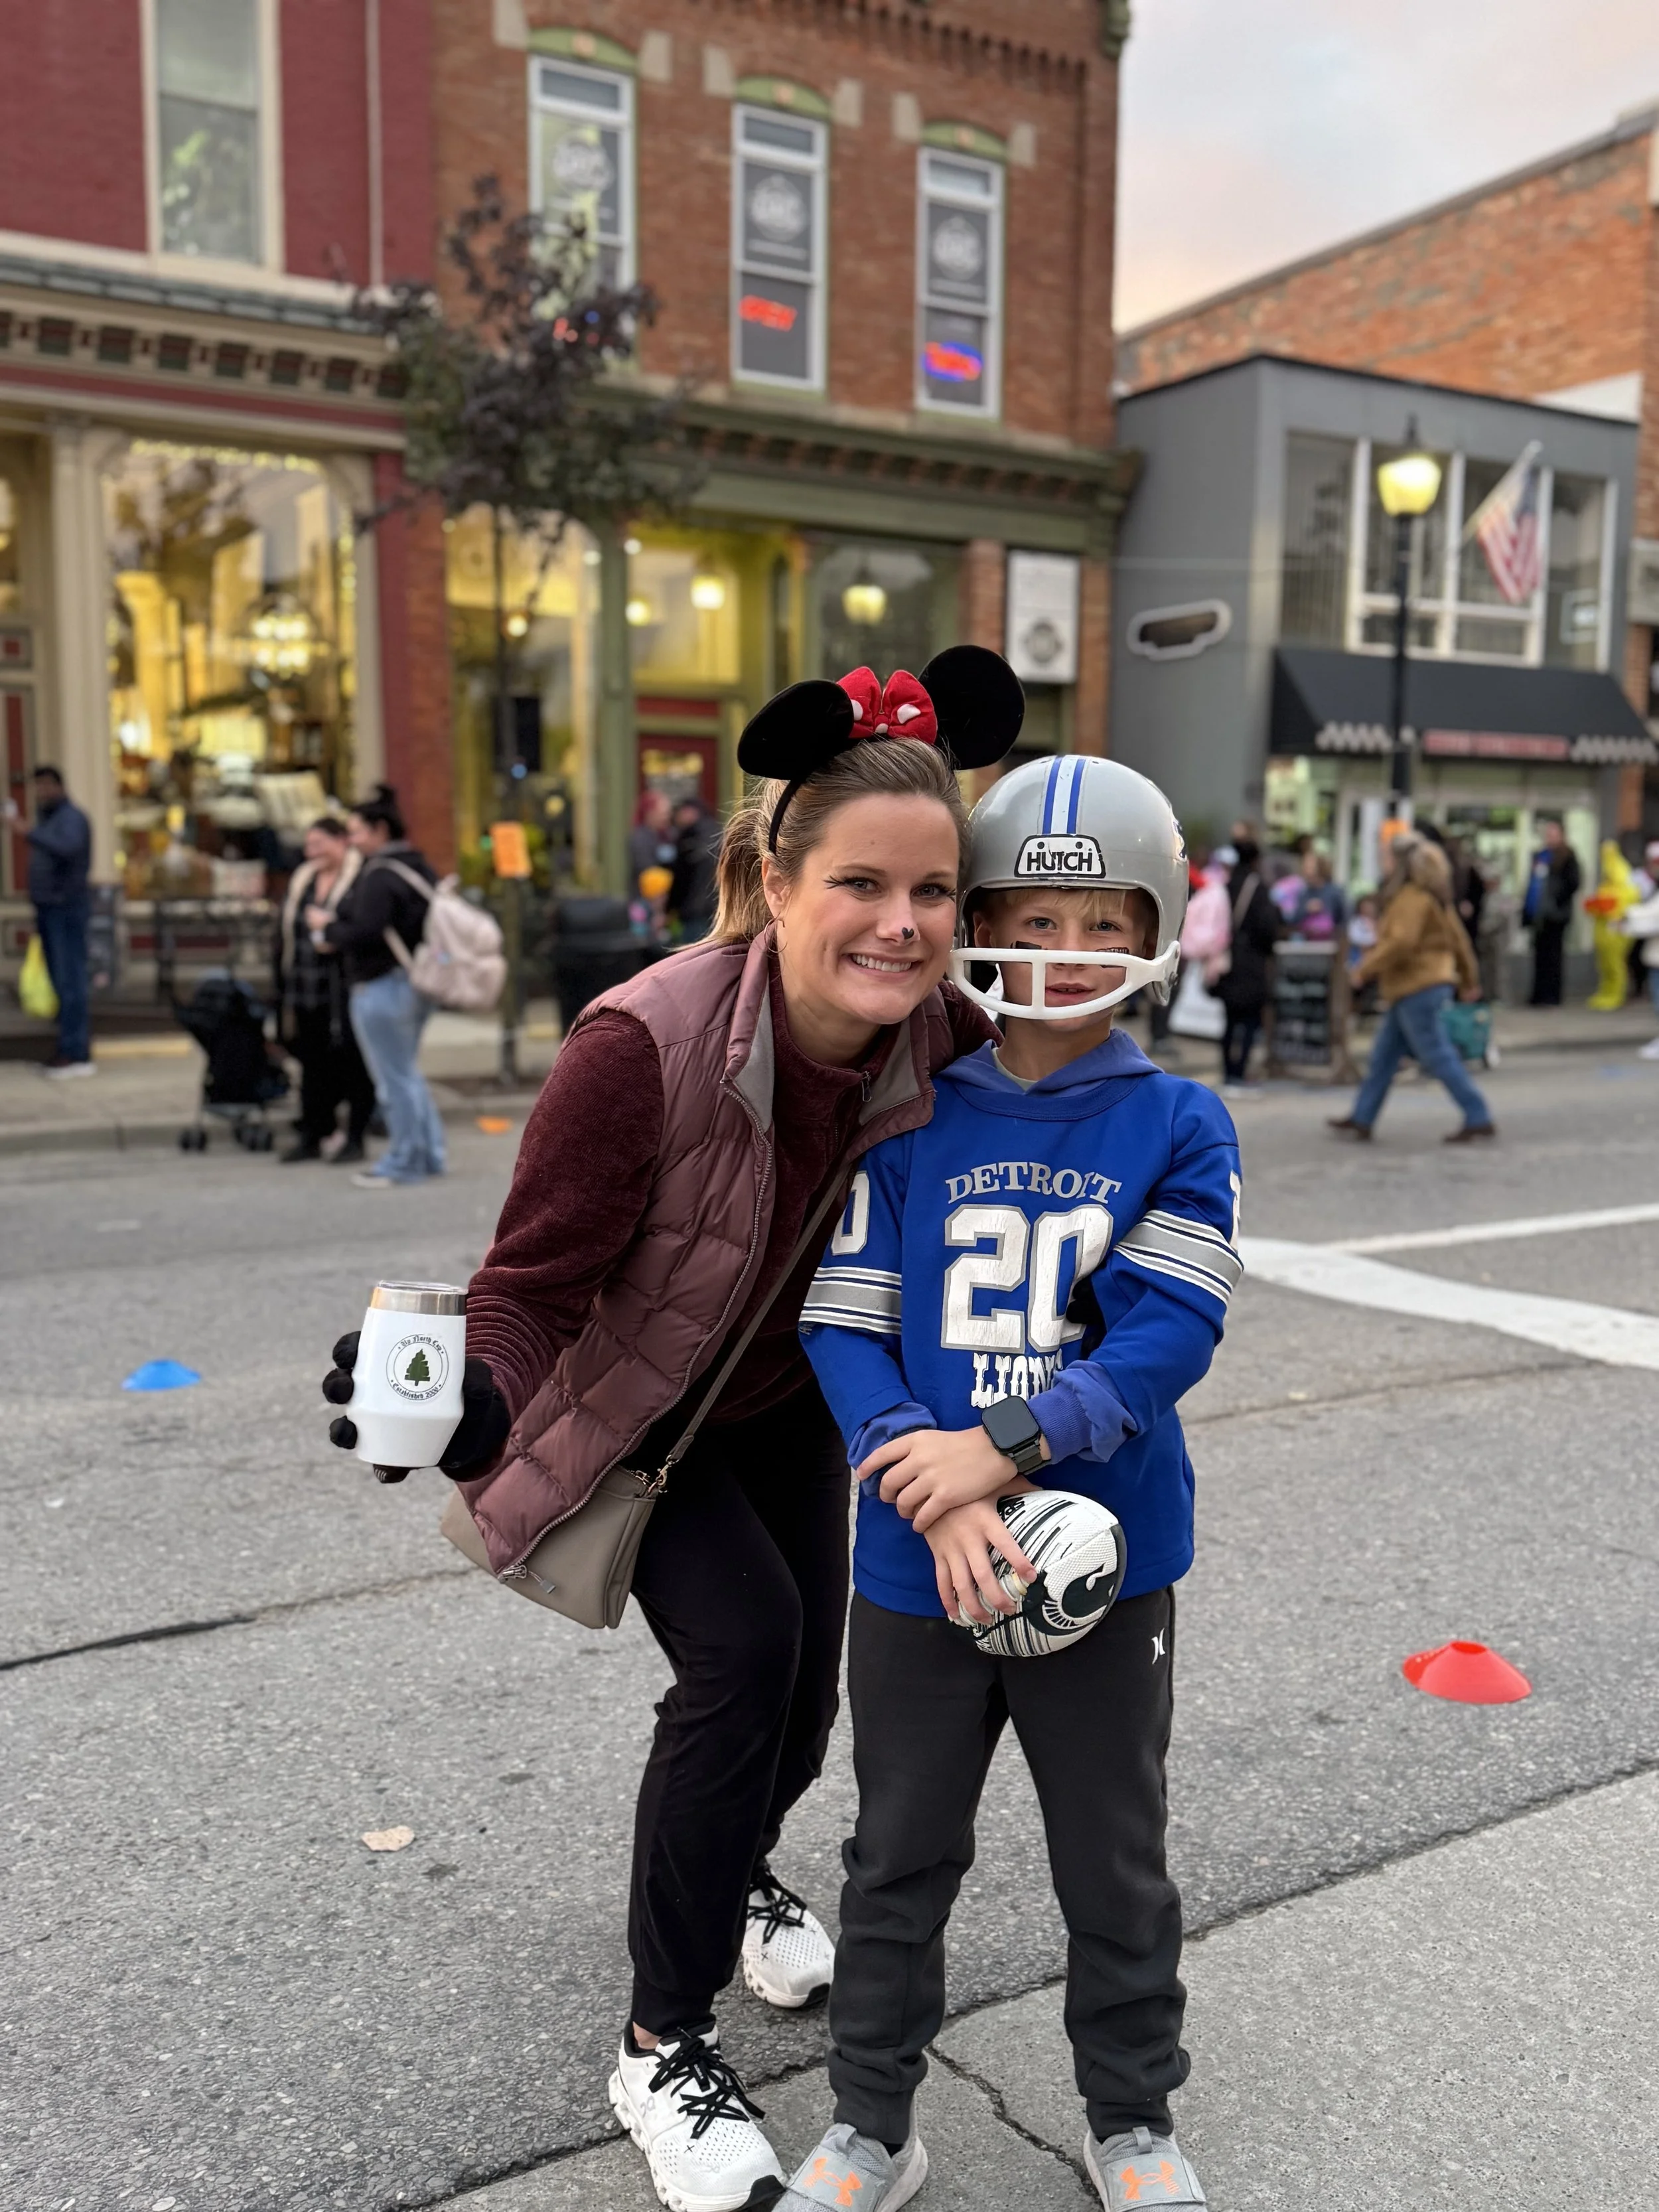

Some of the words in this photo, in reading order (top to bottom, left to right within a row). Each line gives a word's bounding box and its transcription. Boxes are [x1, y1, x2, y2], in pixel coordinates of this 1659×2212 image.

[1027, 850, 1092, 872] HUTCH
[945, 1161, 1122, 1205] DETROIT
[941, 1204, 1114, 1354] 20
[971, 1349, 1063, 1408] LION
